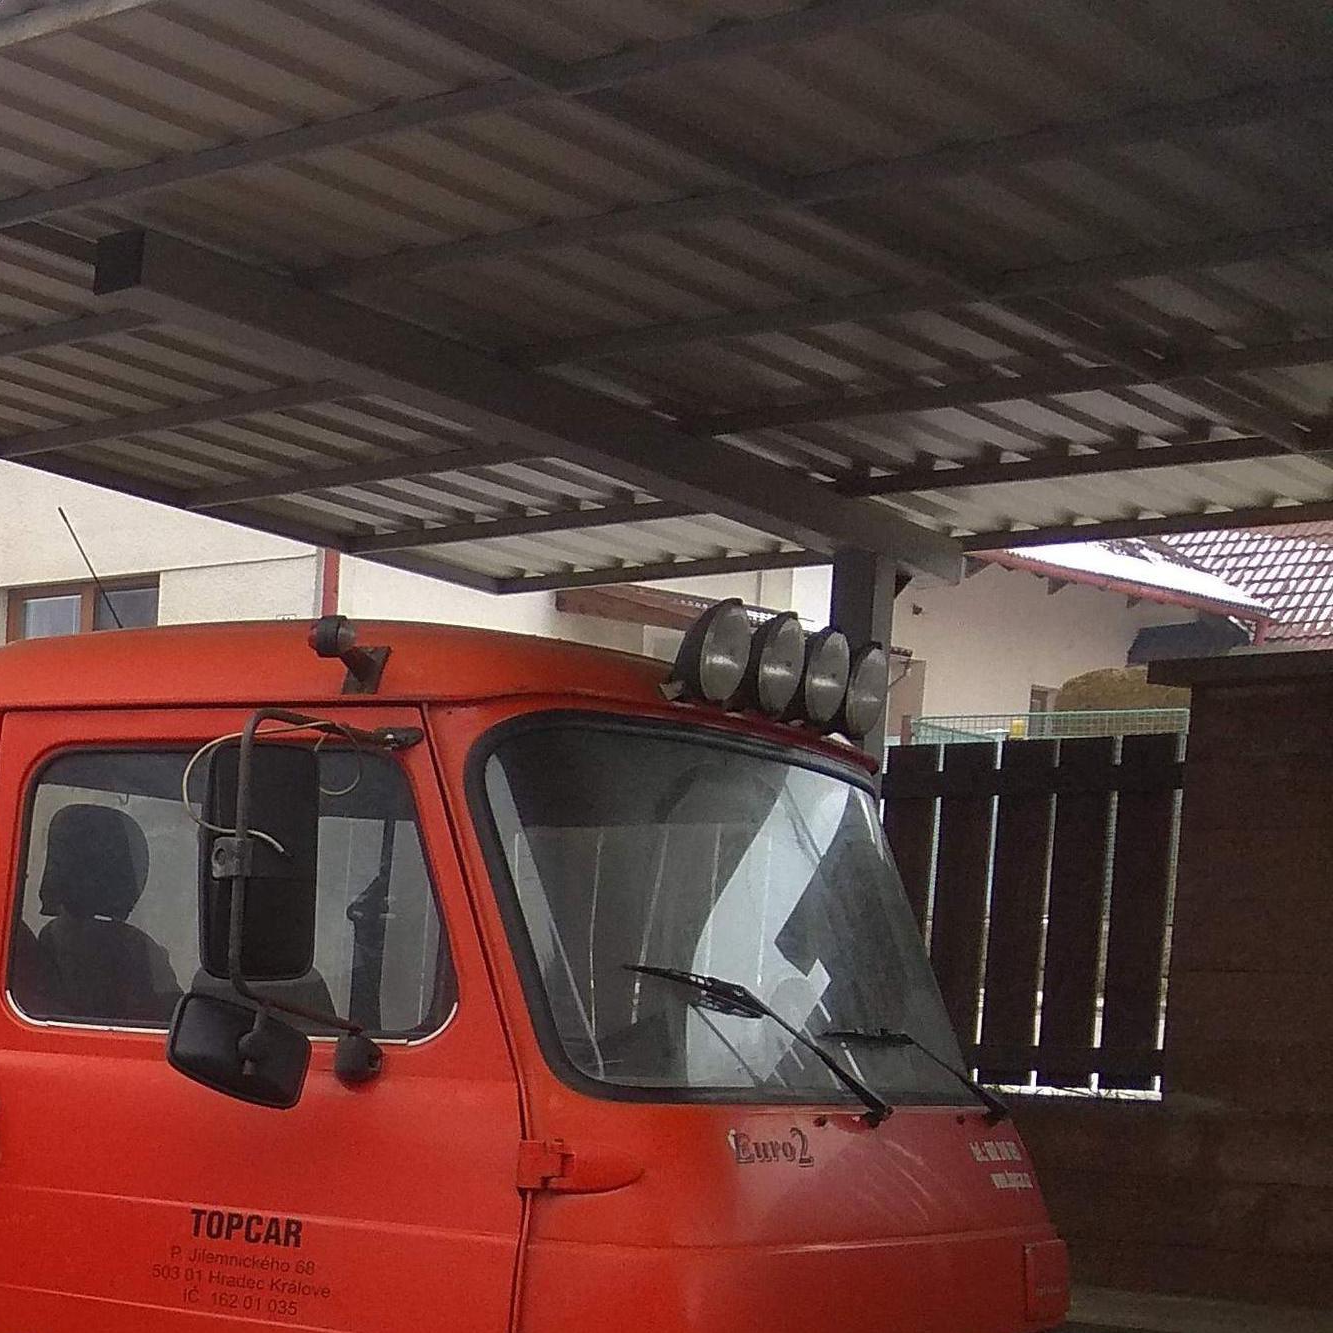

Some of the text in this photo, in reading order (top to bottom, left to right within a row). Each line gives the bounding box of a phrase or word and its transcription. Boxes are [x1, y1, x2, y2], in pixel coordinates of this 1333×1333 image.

[191, 1208, 303, 1248] TOPCAR
[152, 1263, 180, 1280] 503
[185, 1267, 201, 1283] 01
[208, 1269, 264, 1290] Hradec
[268, 1299, 298, 1316] 035
